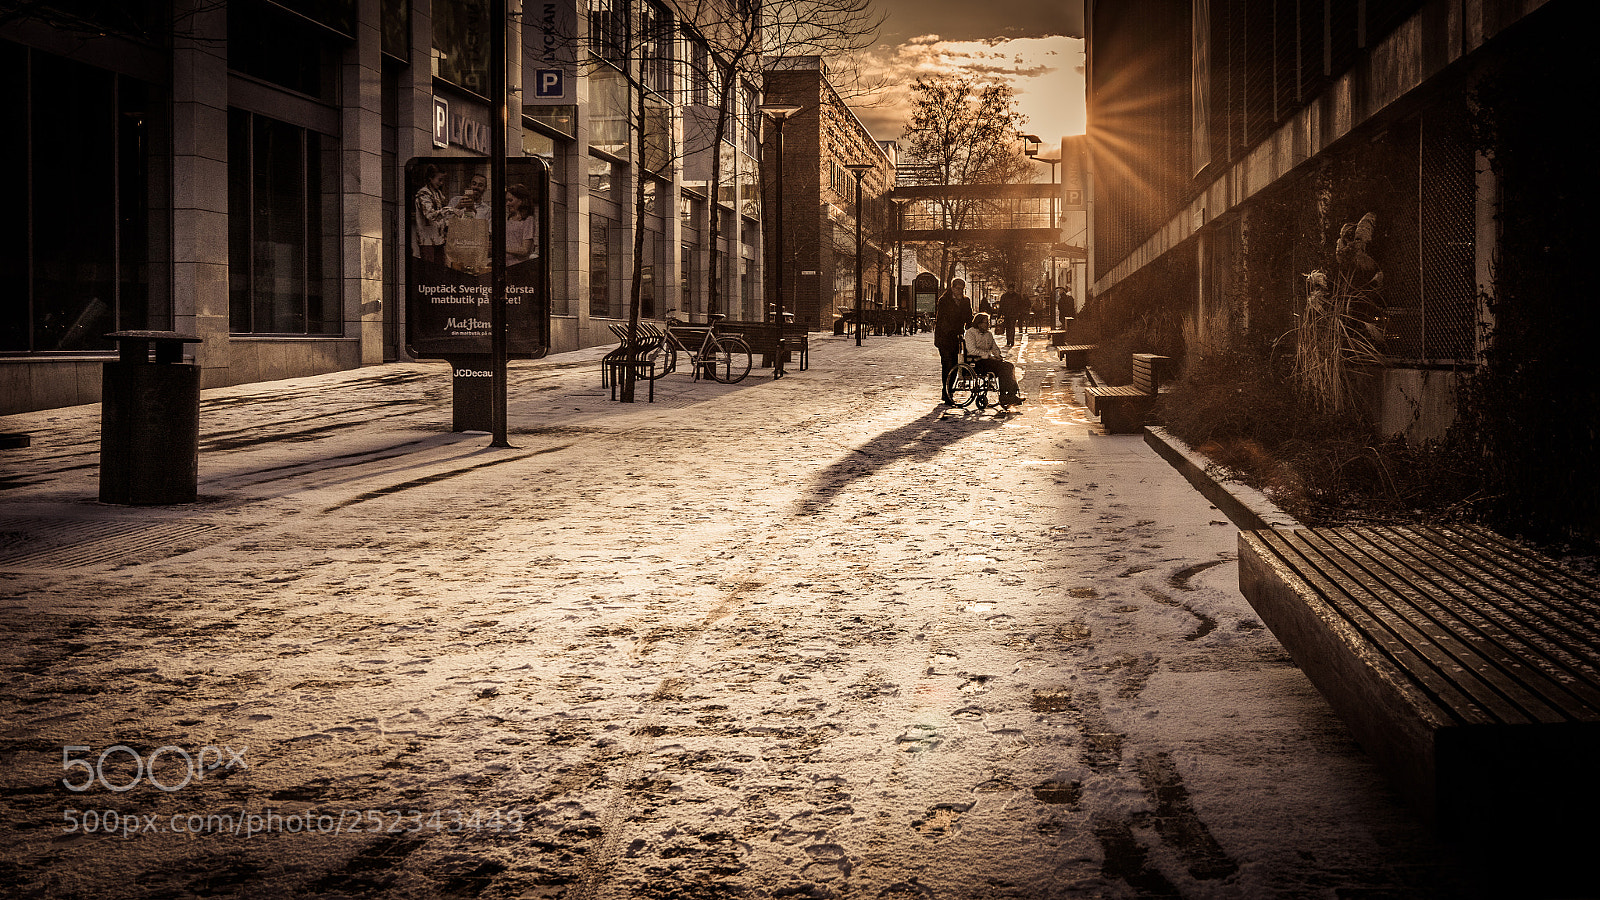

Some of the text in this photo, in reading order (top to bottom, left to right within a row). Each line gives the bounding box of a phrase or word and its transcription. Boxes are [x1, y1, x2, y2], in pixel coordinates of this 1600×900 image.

[543, 3, 556, 61] LYCKAN
[542, 73, 558, 93] P
[436, 105, 446, 138] P
[451, 113, 491, 155] LYCKA
[1069, 191, 1079, 204] P
[418, 284, 535, 296] Upptäck Sverige törsta
[431, 295, 475, 304] matbutik
[477, 295, 490, 306] på
[443, 317, 493, 331] MatHem
[453, 369, 493, 378] JCDecau
